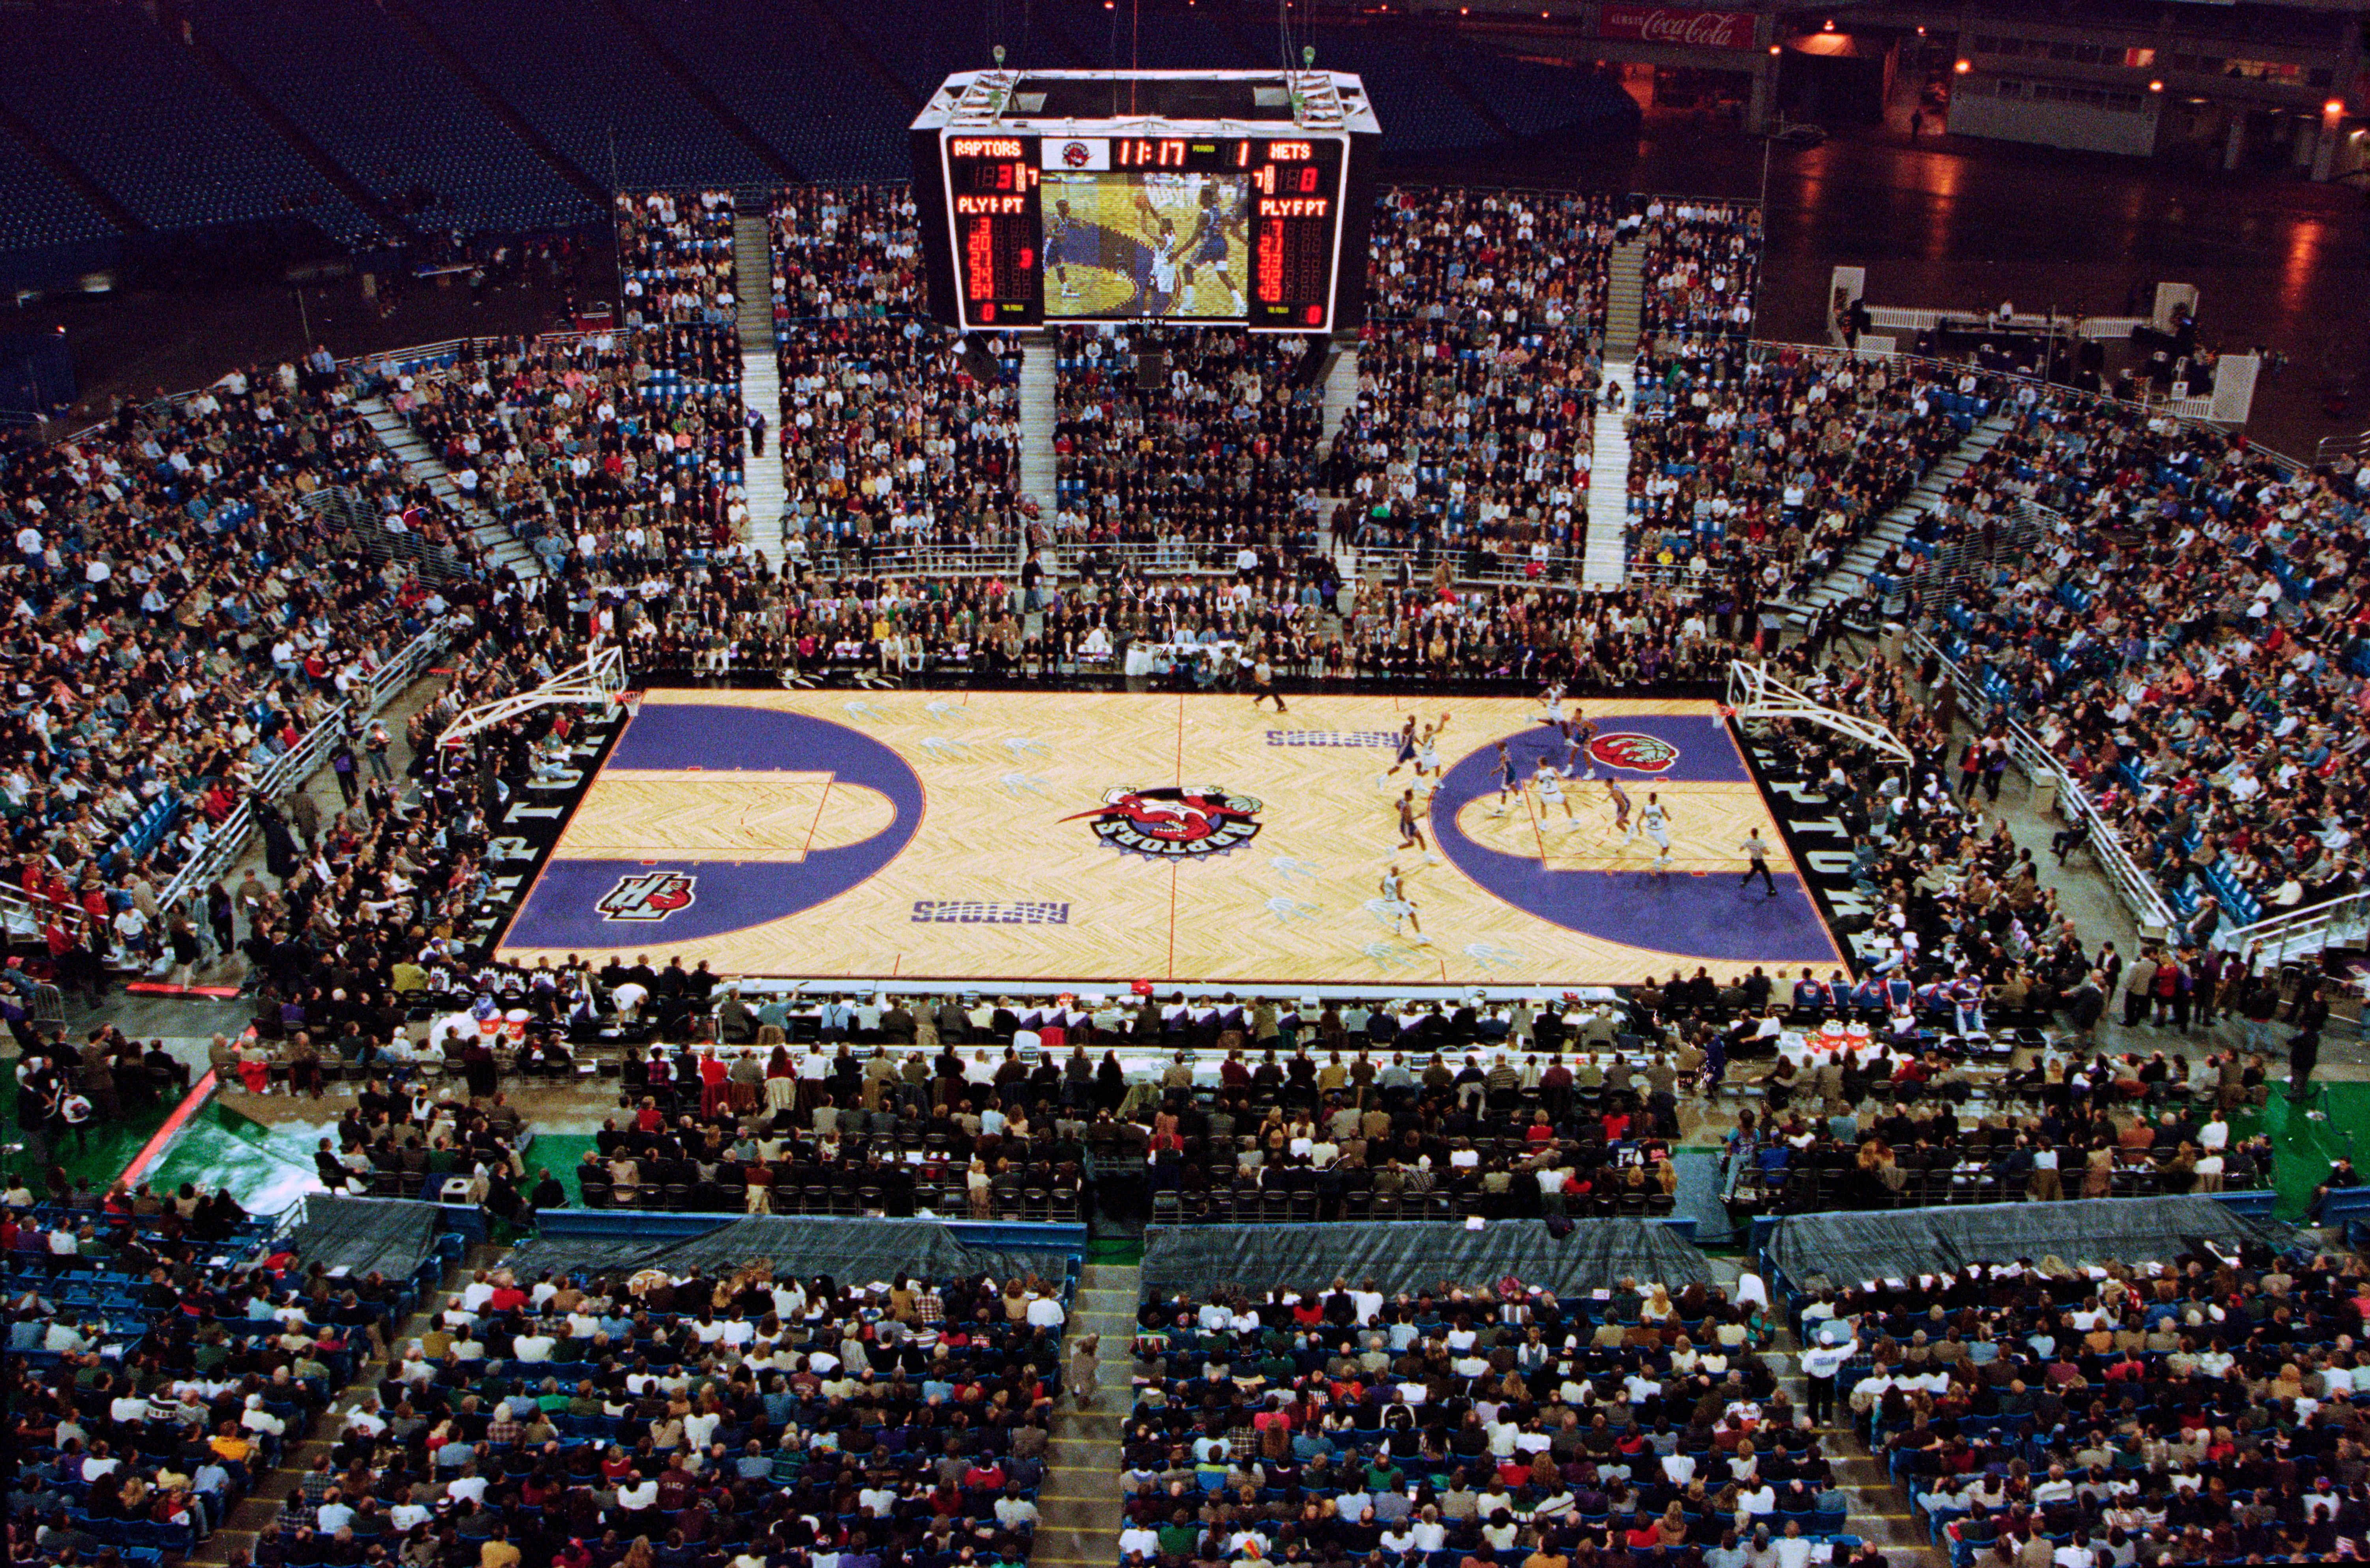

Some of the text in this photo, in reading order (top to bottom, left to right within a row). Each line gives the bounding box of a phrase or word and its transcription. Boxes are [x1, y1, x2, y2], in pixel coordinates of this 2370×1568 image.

[954, 139, 1022, 157] RAPTORS
[1119, 139, 1184, 166] 11:17
[1270, 142, 1311, 159] NETS
[996, 164, 1012, 189] 3
[1028, 167, 1039, 187] 7
[1252, 171, 1263, 188] 7
[1300, 167, 1318, 192] 0
[980, 218, 991, 234] 3
[1271, 220, 1284, 236] 7
[969, 234, 992, 251] 20
[1259, 236, 1283, 253] 21
[969, 251, 992, 267] 21
[1259, 253, 1283, 268] 33
[970, 267, 993, 283] 34
[1259, 268, 1282, 284] 42
[971, 283, 994, 299] 54
[1258, 284, 1281, 302] 43
[982, 303, 995, 322] 0
[1266, 730, 1401, 748] RAPTORS
[1095, 821, 1258, 854] RAPTORS
[911, 900, 1070, 924] RAPTORS
